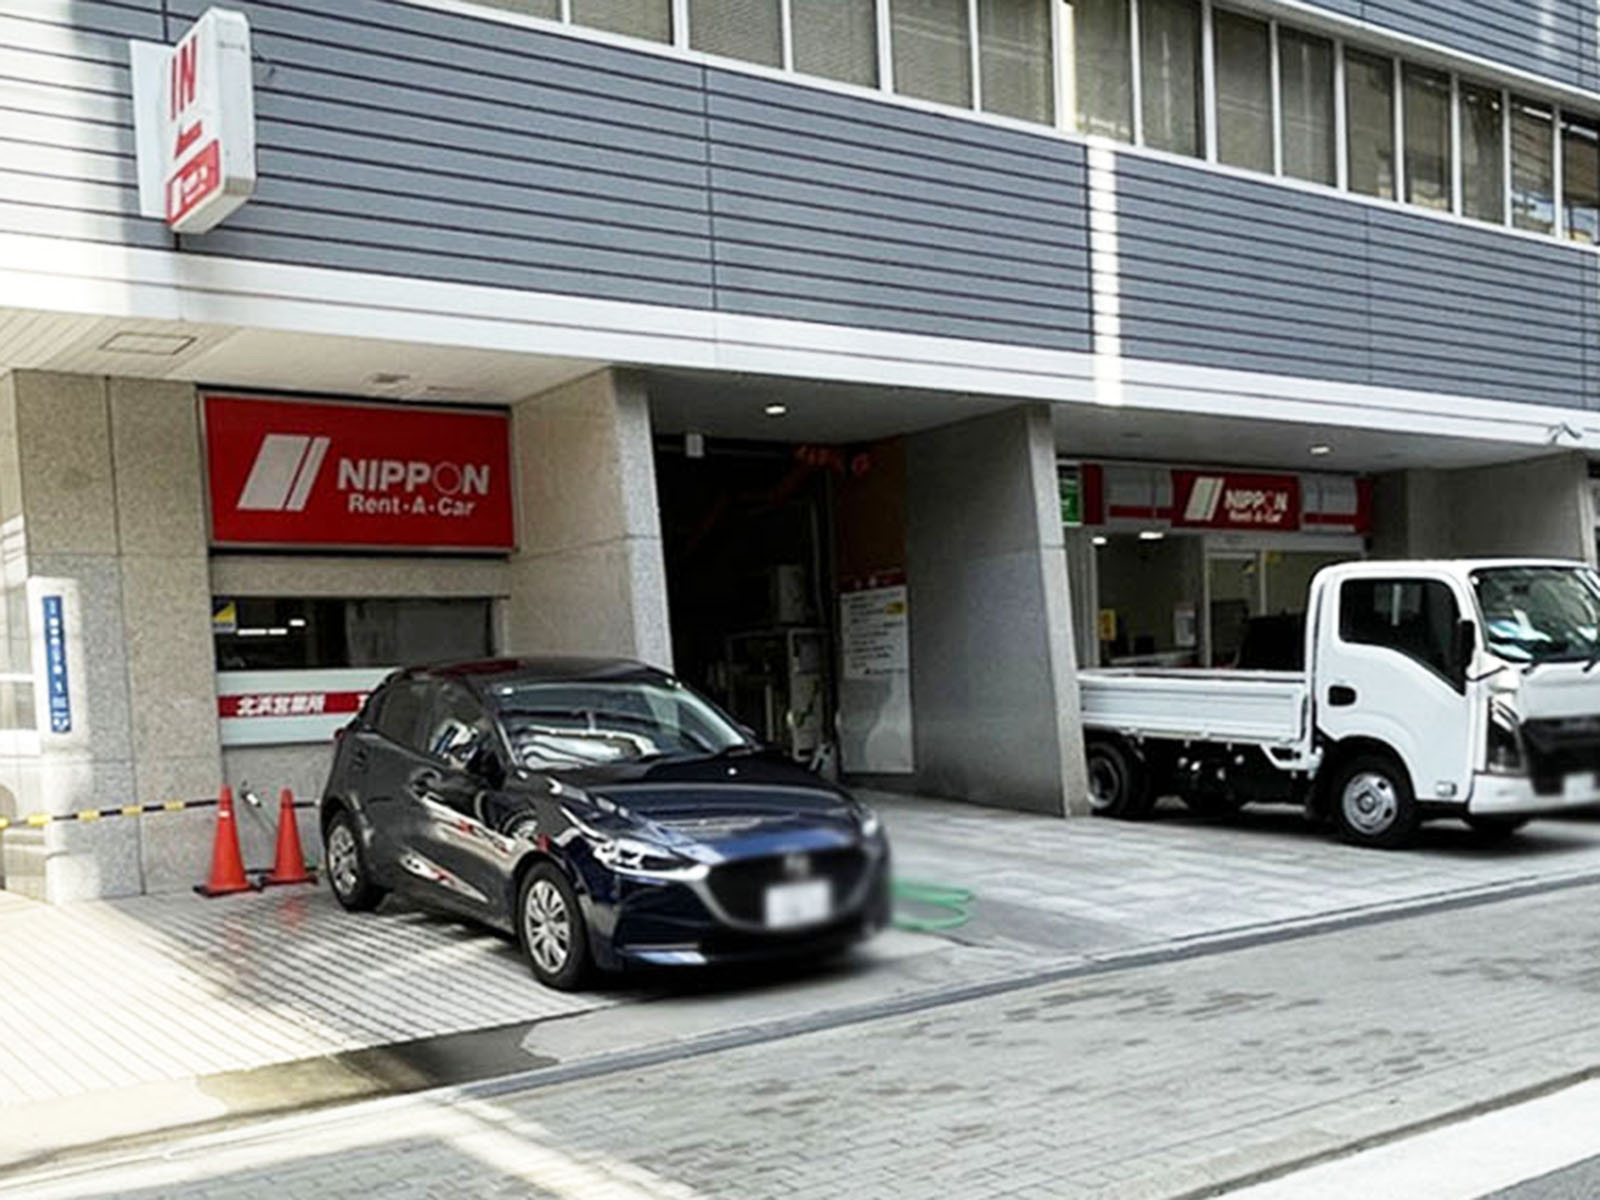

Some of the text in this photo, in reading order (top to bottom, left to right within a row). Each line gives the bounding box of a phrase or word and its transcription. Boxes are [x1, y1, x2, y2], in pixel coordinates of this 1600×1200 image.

[170, 34, 197, 122] IN
[337, 457, 491, 496] NIPPON
[1223, 489, 1288, 512] NIPPON
